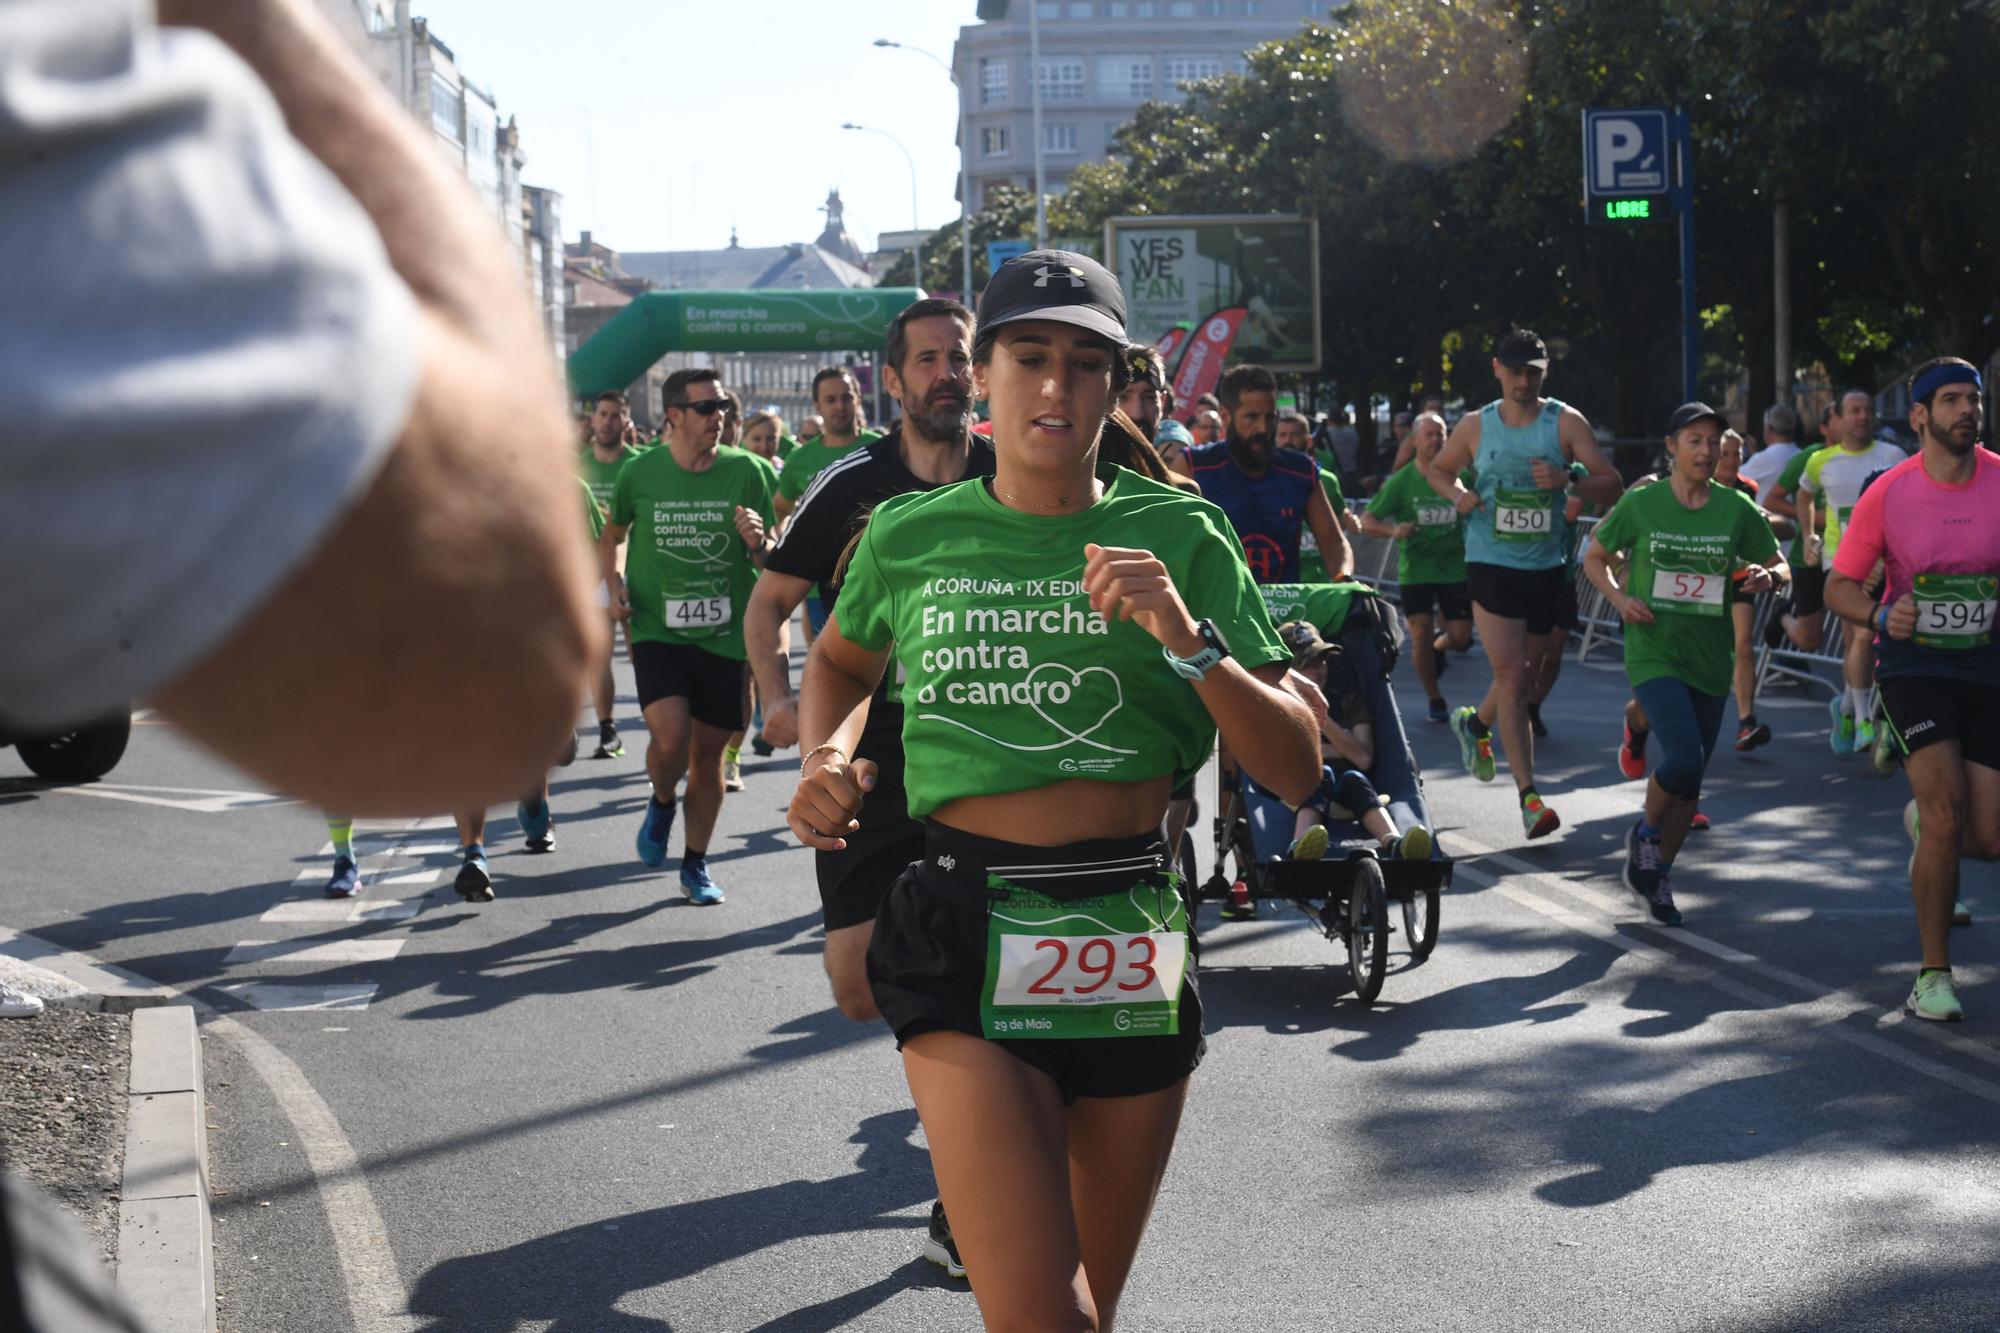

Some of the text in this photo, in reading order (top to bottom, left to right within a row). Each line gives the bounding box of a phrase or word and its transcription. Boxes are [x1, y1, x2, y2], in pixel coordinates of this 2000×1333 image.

[1595, 119, 1644, 188] P
[1606, 200, 1650, 219] LIBRE
[1130, 238, 1183, 260] YES
[1130, 257, 1173, 280] WE
[1131, 277, 1184, 299] FAN
[686, 306, 769, 321] En marcha
[687, 321, 807, 334] contra o cancro
[654, 510, 724, 522] En marcha
[1503, 510, 1544, 529] 450
[654, 524, 697, 535] contra
[656, 537, 664, 546] o
[922, 581, 933, 598] A
[935, 577, 1015, 596] CORUÑA
[1026, 580, 1045, 597] IX
[1673, 574, 1706, 598] 52
[676, 599, 722, 623] 445
[922, 602, 1109, 638] En marcha
[1929, 602, 1986, 629] 594
[921, 639, 1029, 673] contra
[918, 683, 937, 704] o
[1027, 936, 1156, 995] 293
[994, 1018, 1053, 1032] 29 de Maio
